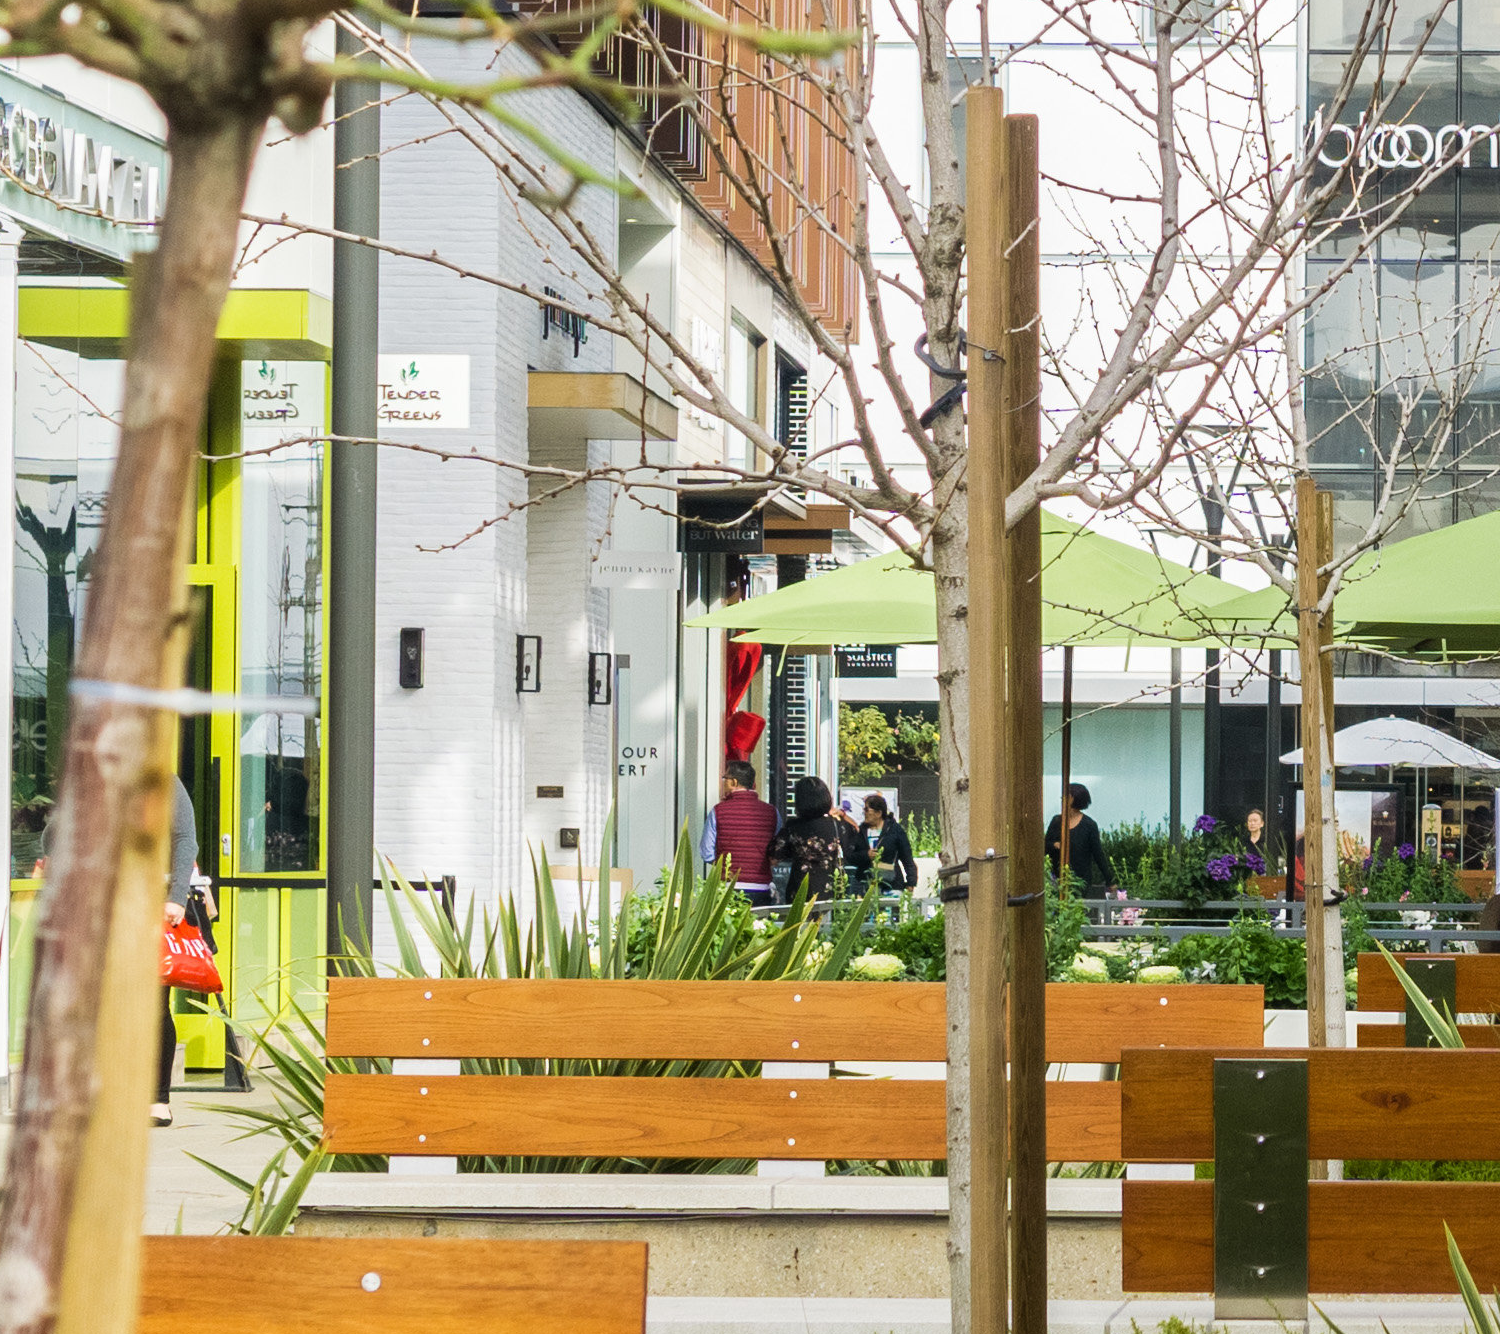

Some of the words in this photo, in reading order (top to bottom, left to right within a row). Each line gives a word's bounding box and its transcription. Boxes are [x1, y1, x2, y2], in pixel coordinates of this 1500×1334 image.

[378, 384, 441, 400] TENDER
[377, 404, 442, 422] GREENS
[714, 529, 759, 540] water
[846, 653, 893, 662] SOLSTICE
[618, 764, 647, 776] ERT
[164, 932, 205, 959] GAP
